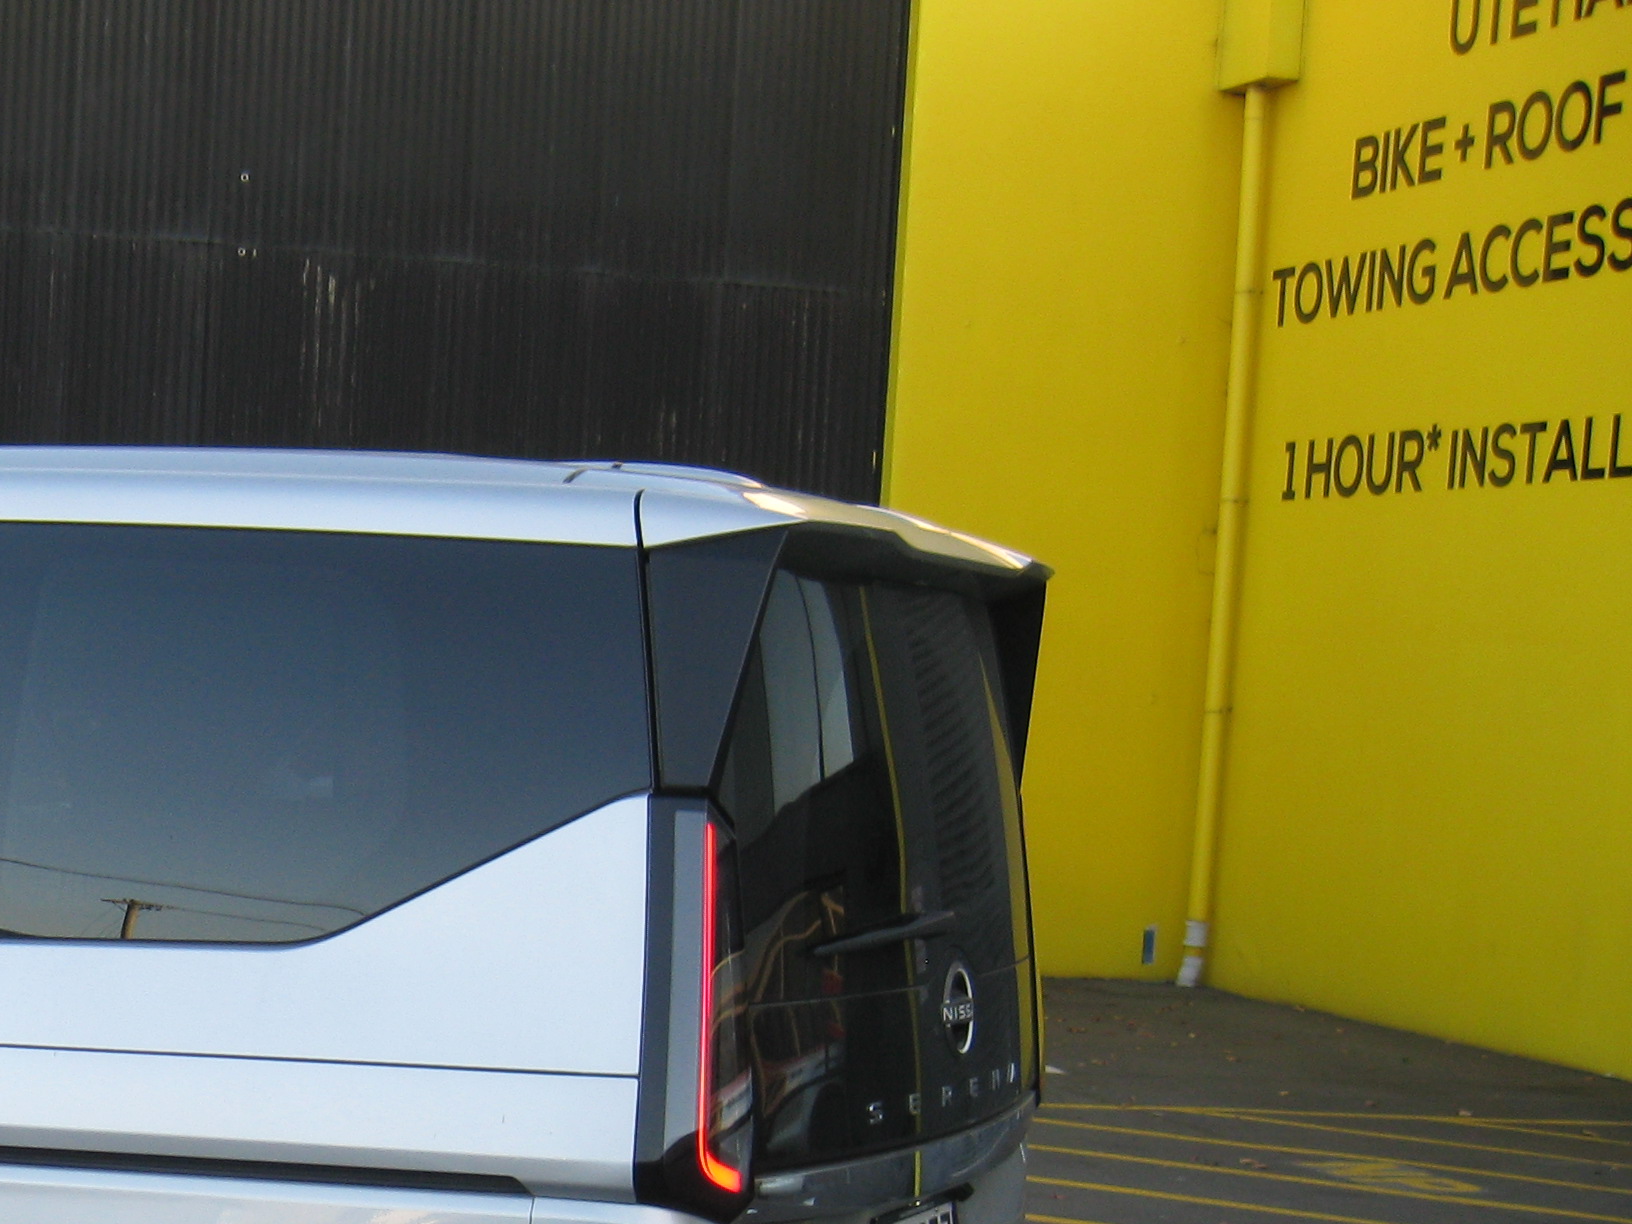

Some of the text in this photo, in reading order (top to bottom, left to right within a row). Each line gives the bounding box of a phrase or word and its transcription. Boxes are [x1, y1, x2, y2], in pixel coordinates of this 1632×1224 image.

[1351, 116, 1447, 199] BIKE
[1483, 70, 1627, 169] ROOF
[1272, 238, 1437, 327] TOWING
[1281, 441, 1297, 501] 1
[942, 1003, 974, 1022] NISS
